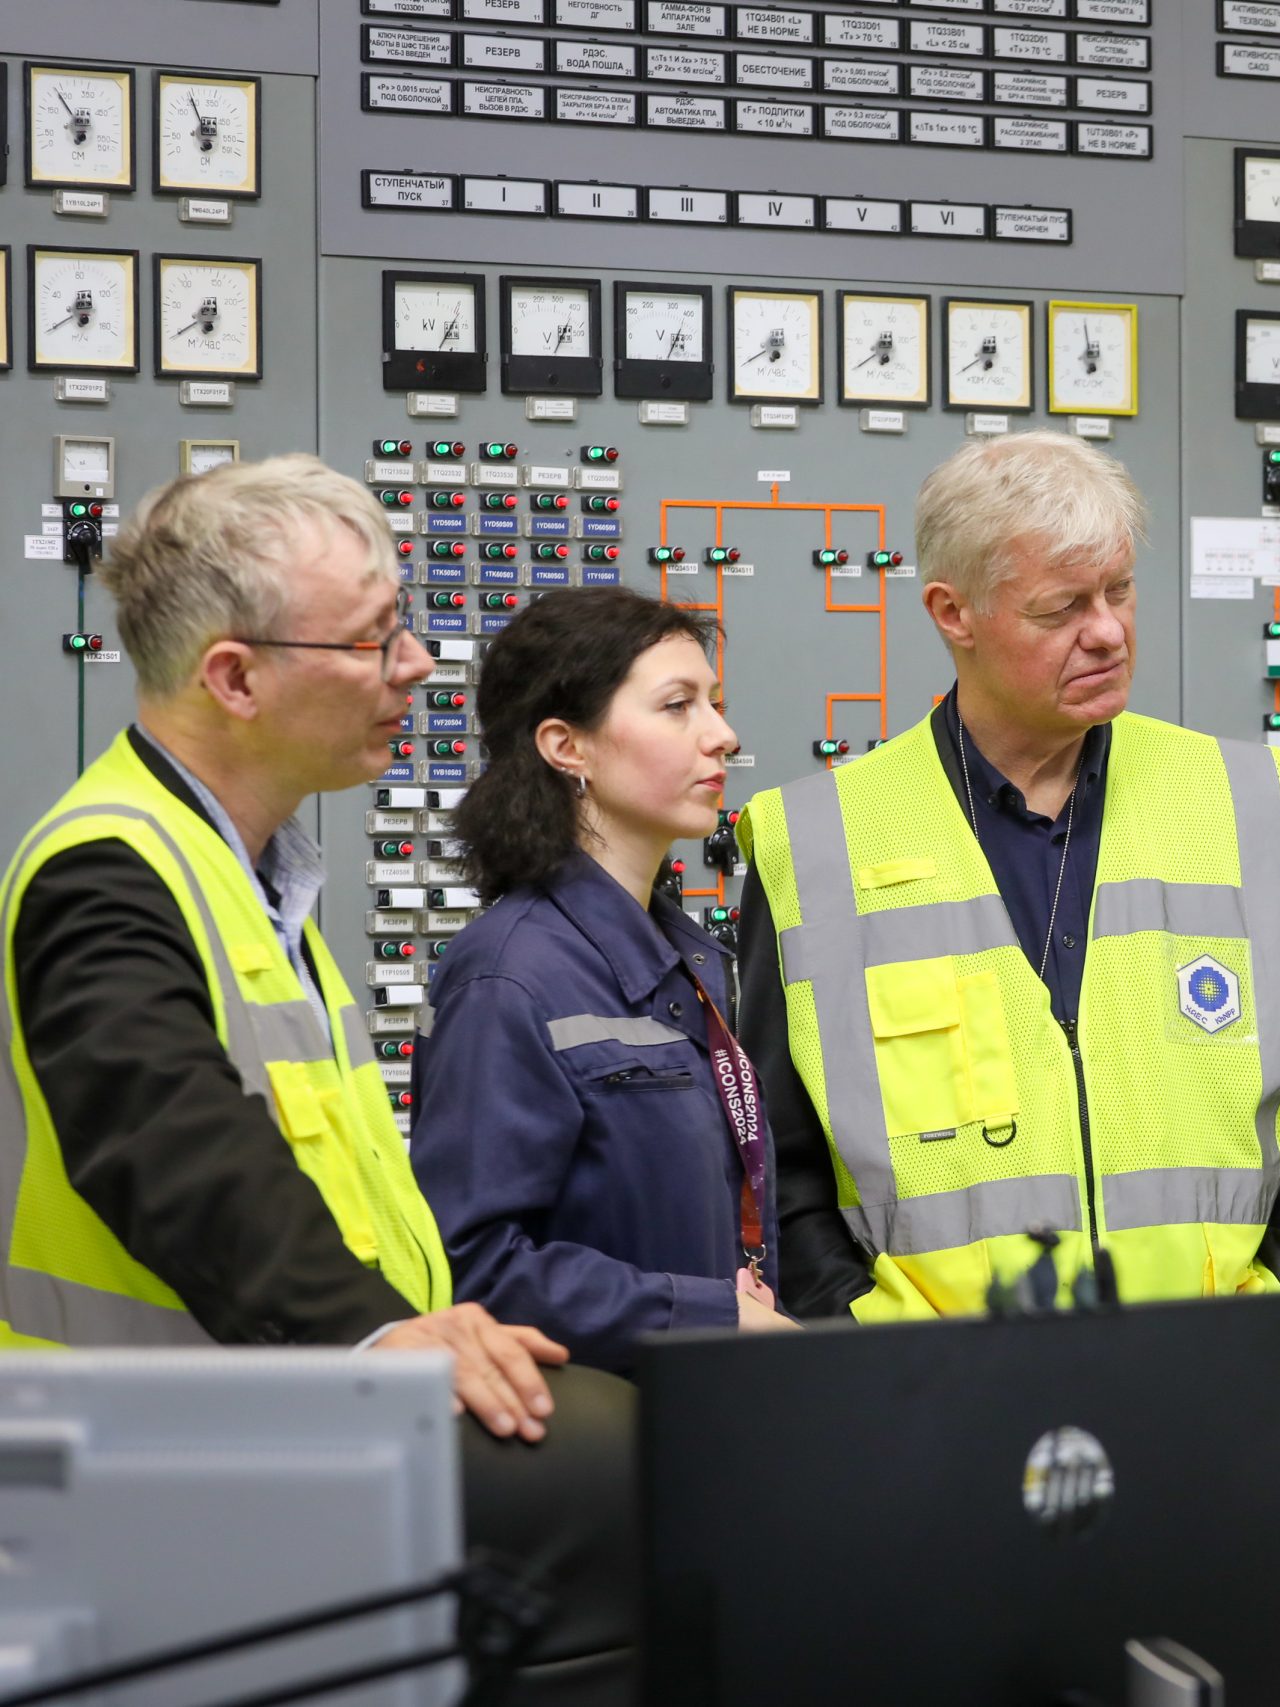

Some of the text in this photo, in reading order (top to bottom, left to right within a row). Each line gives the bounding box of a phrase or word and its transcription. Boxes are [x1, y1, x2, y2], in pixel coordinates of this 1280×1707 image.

[485, 0, 520, 9] РЕЗЕРВ
[568, 1, 622, 12] НЕГОТОВНОСТЬ
[661, 4, 704, 13] ГАММА-ФОН
[1101, 7, 1134, 15] ОТКРЫТА
[661, 13, 710, 23] АППАРАТНОМ
[746, 13, 801, 24] 1TQ34B01 «L»
[1239, 16, 1276, 27] ТЕХВОДЫ
[676, 23, 695, 31] ЗАЛЕ
[842, 20, 880, 30] 1TQ33D01
[747, 25, 800, 37] НЕ В НОРМЕ
[397, 34, 440, 43] РАЗРЕШЕНИЯ
[863, 33, 872, 41] 70
[948, 40, 957, 48] 25
[486, 47, 520, 57] РЕЗЕРВ
[583, 49, 607, 58] РДЭС.
[567, 58, 623, 70] ВОДА ПОШЛА
[743, 64, 806, 77] ОБЕСТОЧЕНИЕ
[832, 76, 889, 87] ПОД ОБОЛОЧКОЙ
[933, 79, 975, 89] ОБОЛОЧКОЙ
[475, 86, 532, 96] НЕИСПРАВНОСТЬ
[1096, 89, 1128, 99] РЕЗЕРВ
[397, 94, 441, 103] ОБОЛОЧКОЙ
[485, 95, 507, 103] ЦЕПЕЙ
[560, 93, 609, 102] НЕИСПРАВНОСТЬ
[675, 98, 696, 106] РДЭС.
[655, 107, 700, 116] АВТОМАТИКА
[759, 107, 805, 117] ПОДПИТКИ
[667, 117, 705, 125] ВЫВЕДЕНА
[765, 119, 774, 128] 10
[848, 121, 891, 129] ОБОЛОЧКОЙ
[1109, 142, 1136, 150] НОРМЕ
[72, 152, 85, 160] СМ
[201, 157, 210, 166] СМ
[375, 177, 445, 190] СТУПЕНЧАТЫЙ
[398, 191, 422, 201] ПУСК
[681, 198, 694, 212] III
[768, 202, 783, 216] IV
[857, 208, 867, 222] V
[940, 211, 955, 225] VI
[569, 303, 580, 311] 400
[422, 318, 435, 331] kV
[543, 332, 552, 343] V
[656, 330, 665, 341] V
[383, 918, 407, 926] РЕЗЕРВ
[436, 917, 460, 925] РЕЗЕРВ
[714, 1048, 747, 1145] #ICONS2024
